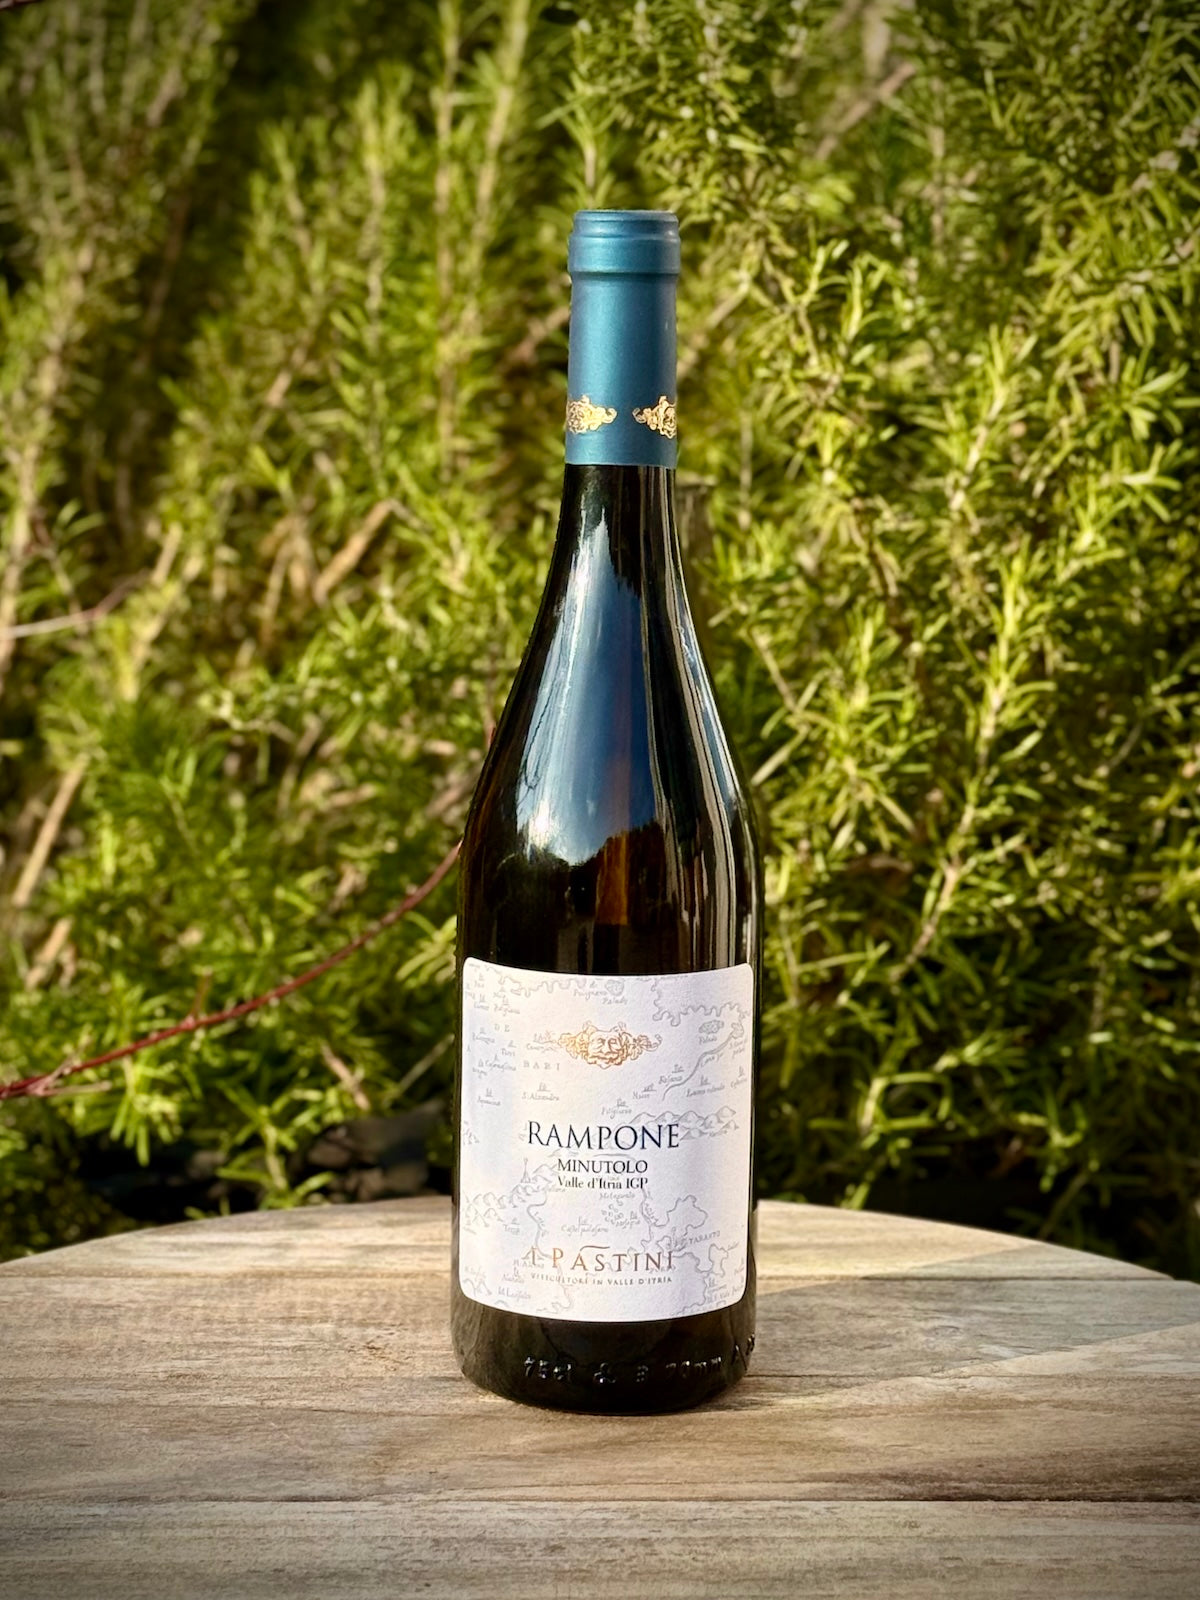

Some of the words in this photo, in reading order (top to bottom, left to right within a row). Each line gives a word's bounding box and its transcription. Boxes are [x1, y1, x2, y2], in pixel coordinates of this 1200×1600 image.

[527, 1119, 680, 1151] RAMPONE
[557, 1158, 649, 1175] MINUTOLO
[557, 1175, 584, 1189] Valle
[587, 1176, 622, 1190] d'Itria
[626, 1177, 649, 1191] IGP
[552, 1245, 674, 1272] PASTINI
[591, 1278, 603, 1287] IN
[608, 1278, 634, 1286] VALLE
[638, 1276, 673, 1286] D'ITRIA
